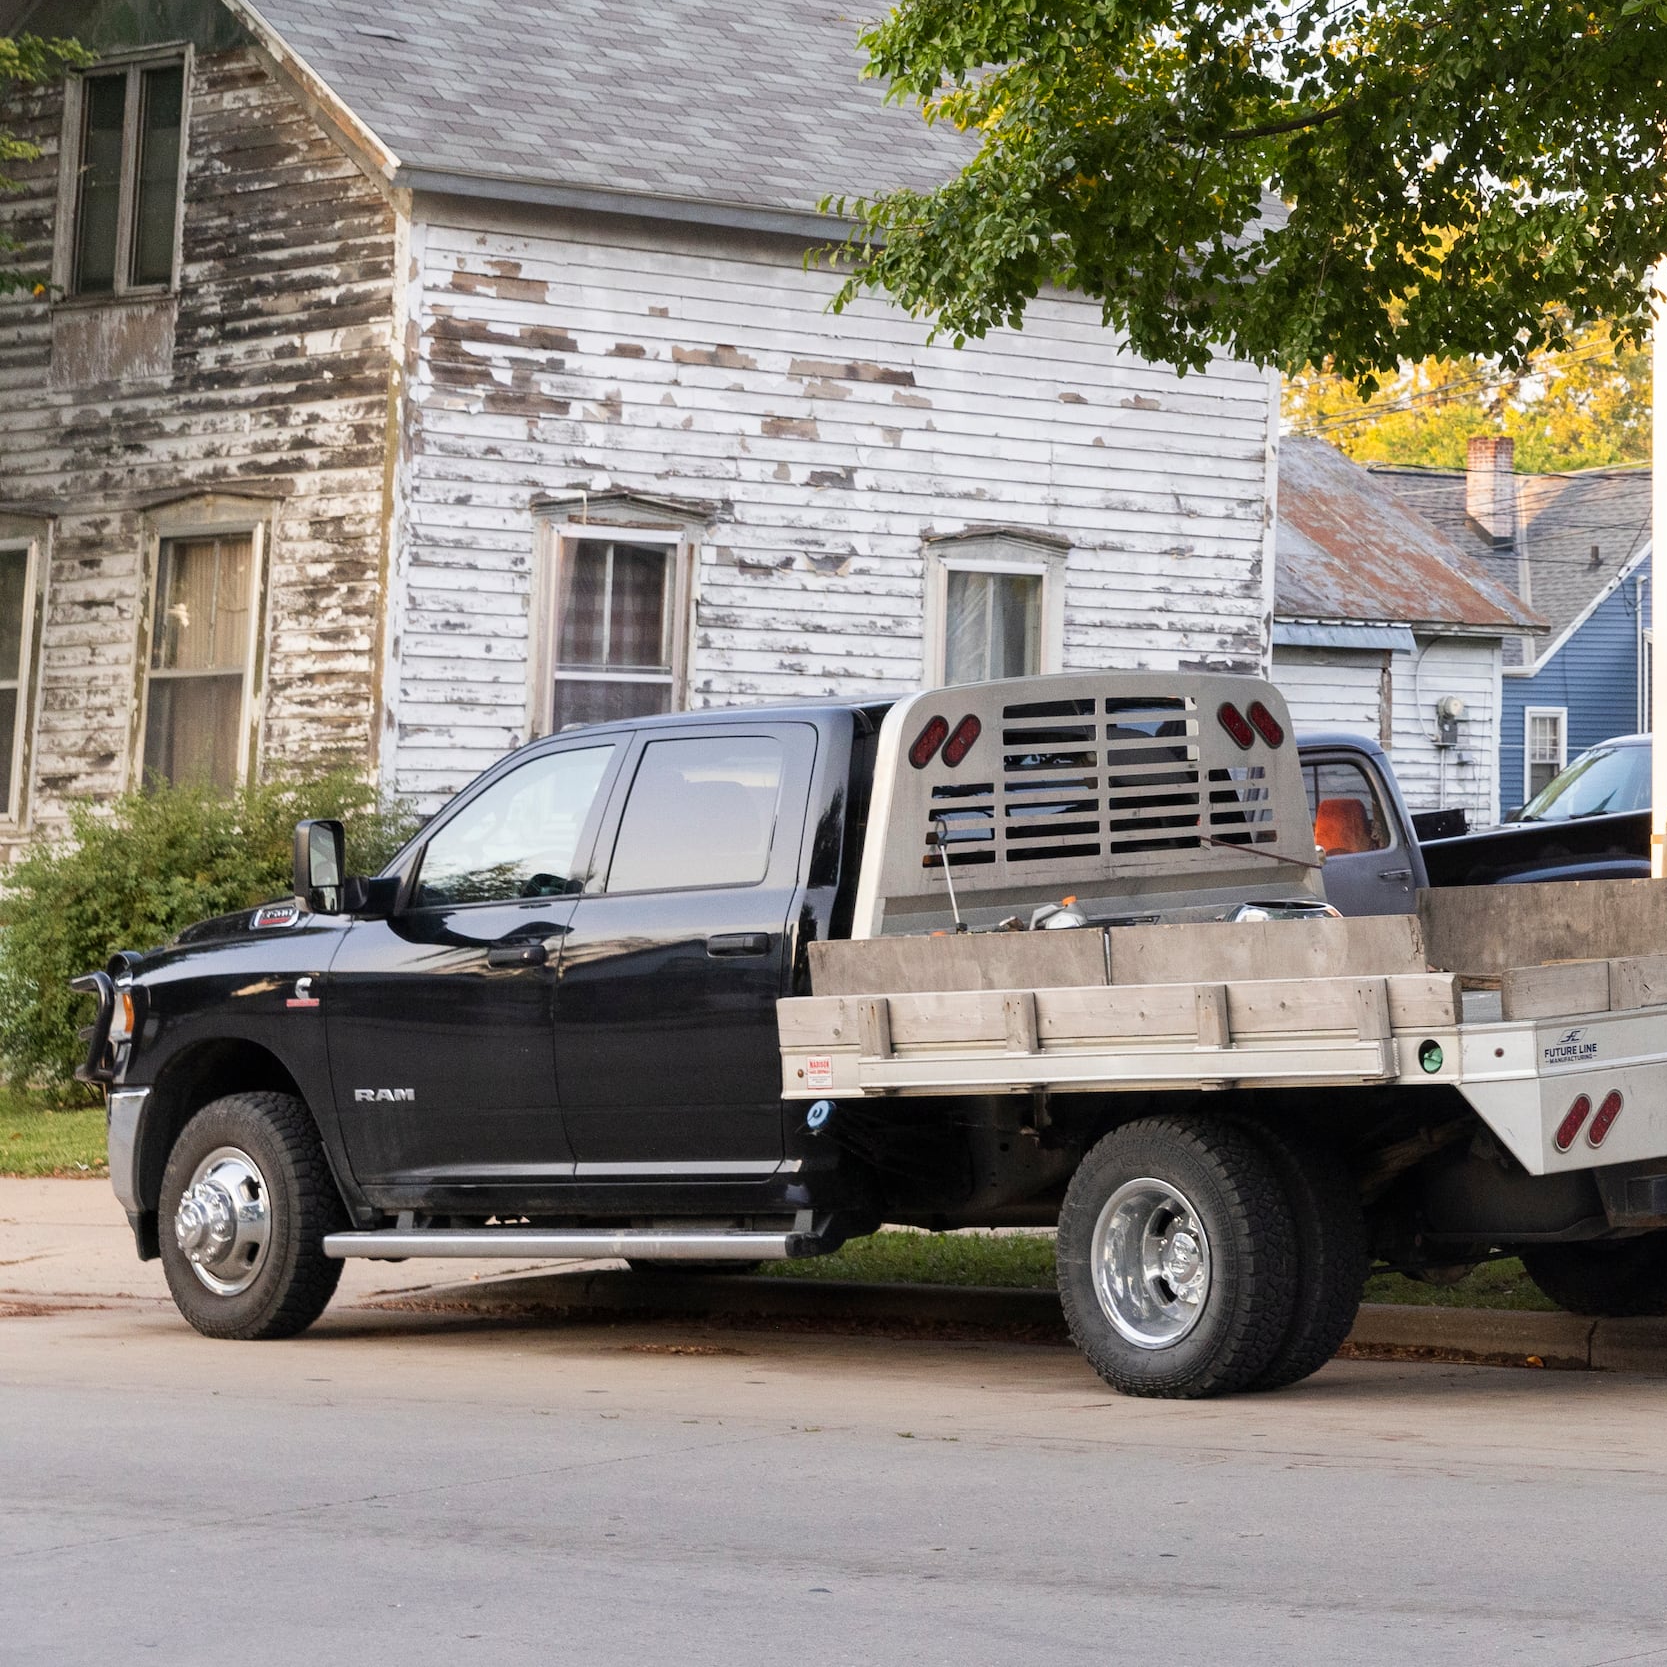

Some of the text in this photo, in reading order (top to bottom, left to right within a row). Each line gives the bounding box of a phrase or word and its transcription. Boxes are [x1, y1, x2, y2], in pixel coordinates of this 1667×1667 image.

[1544, 1043, 1598, 1058] FUTURE LINE
[1549, 1054, 1593, 1064] MANUFACTURING
[354, 1088, 416, 1102] RAM
